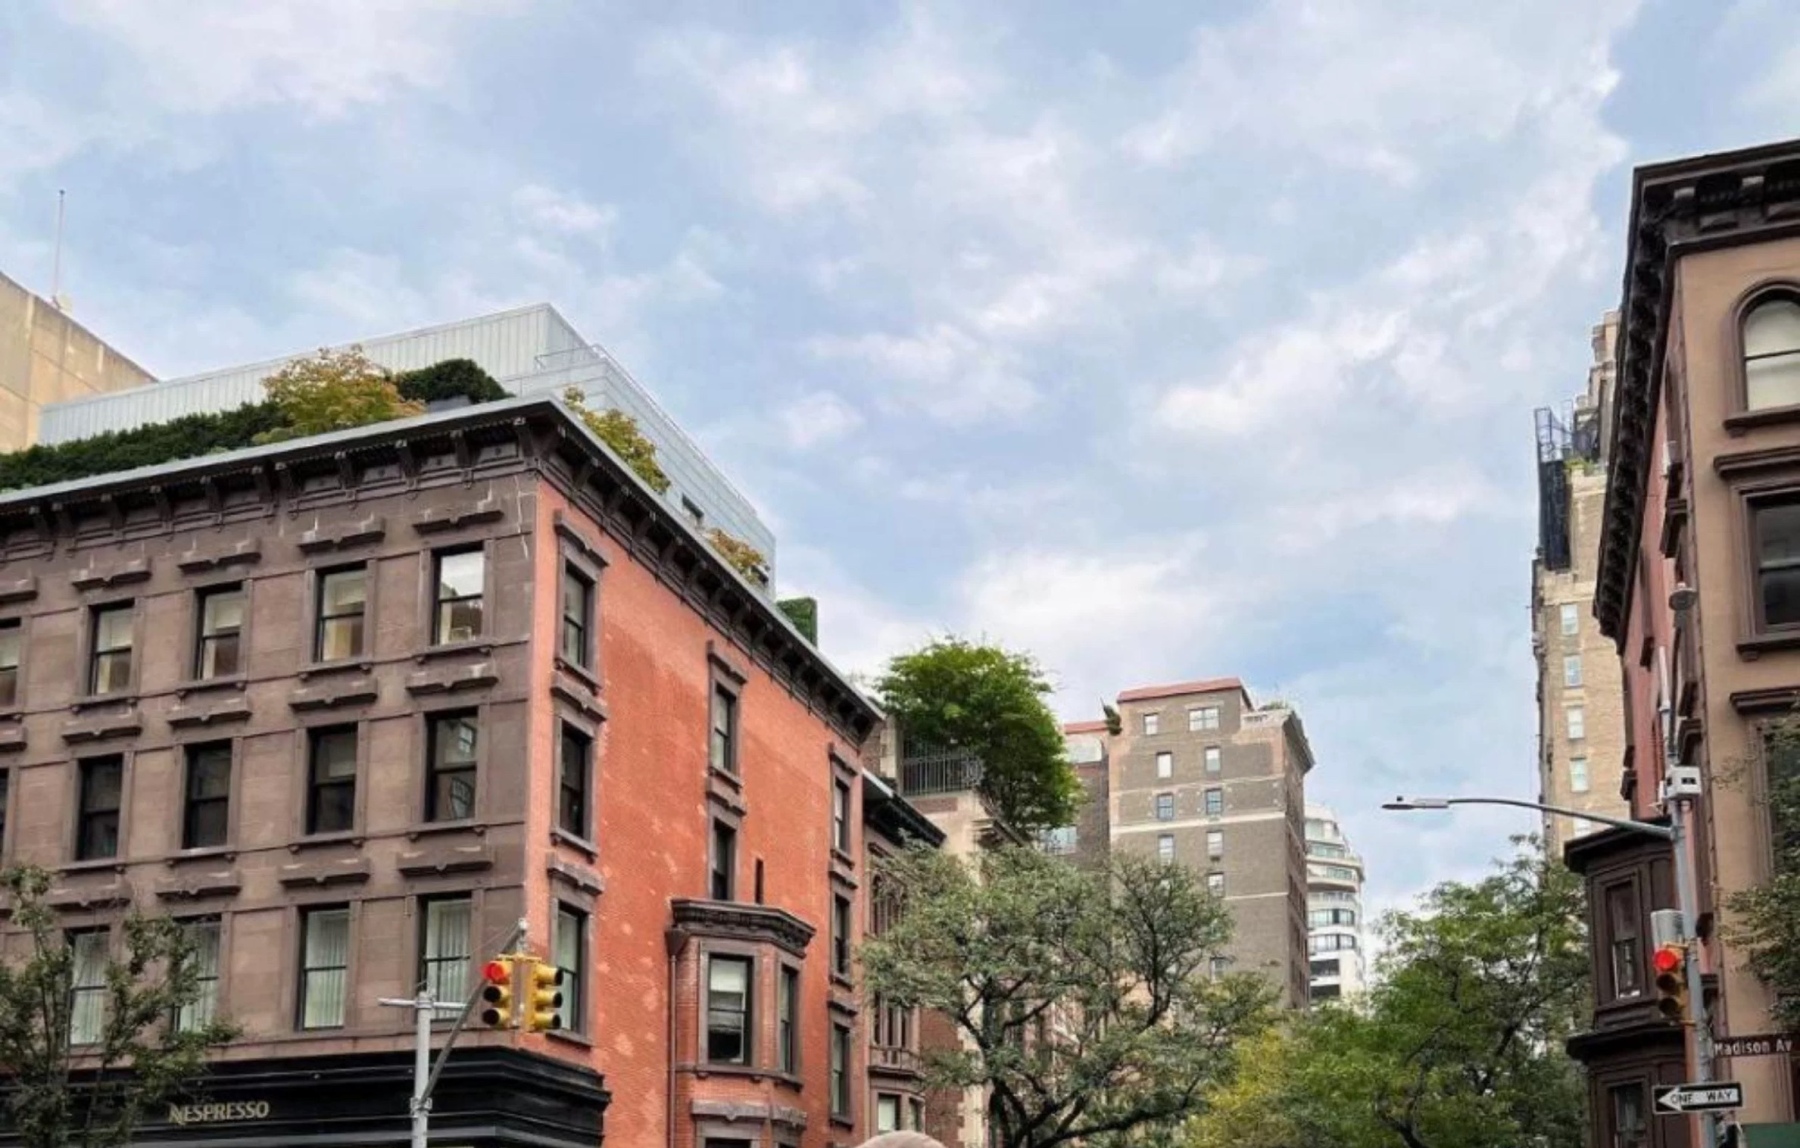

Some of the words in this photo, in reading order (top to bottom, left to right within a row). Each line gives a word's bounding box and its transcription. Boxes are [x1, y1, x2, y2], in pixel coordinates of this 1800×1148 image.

[1714, 1041, 1770, 1056] Madison
[1775, 1038, 1793, 1052] Av
[1670, 1092, 1693, 1105] ONE
[1706, 1090, 1733, 1102] WAY
[168, 1101, 270, 1125] NESPRESSO
